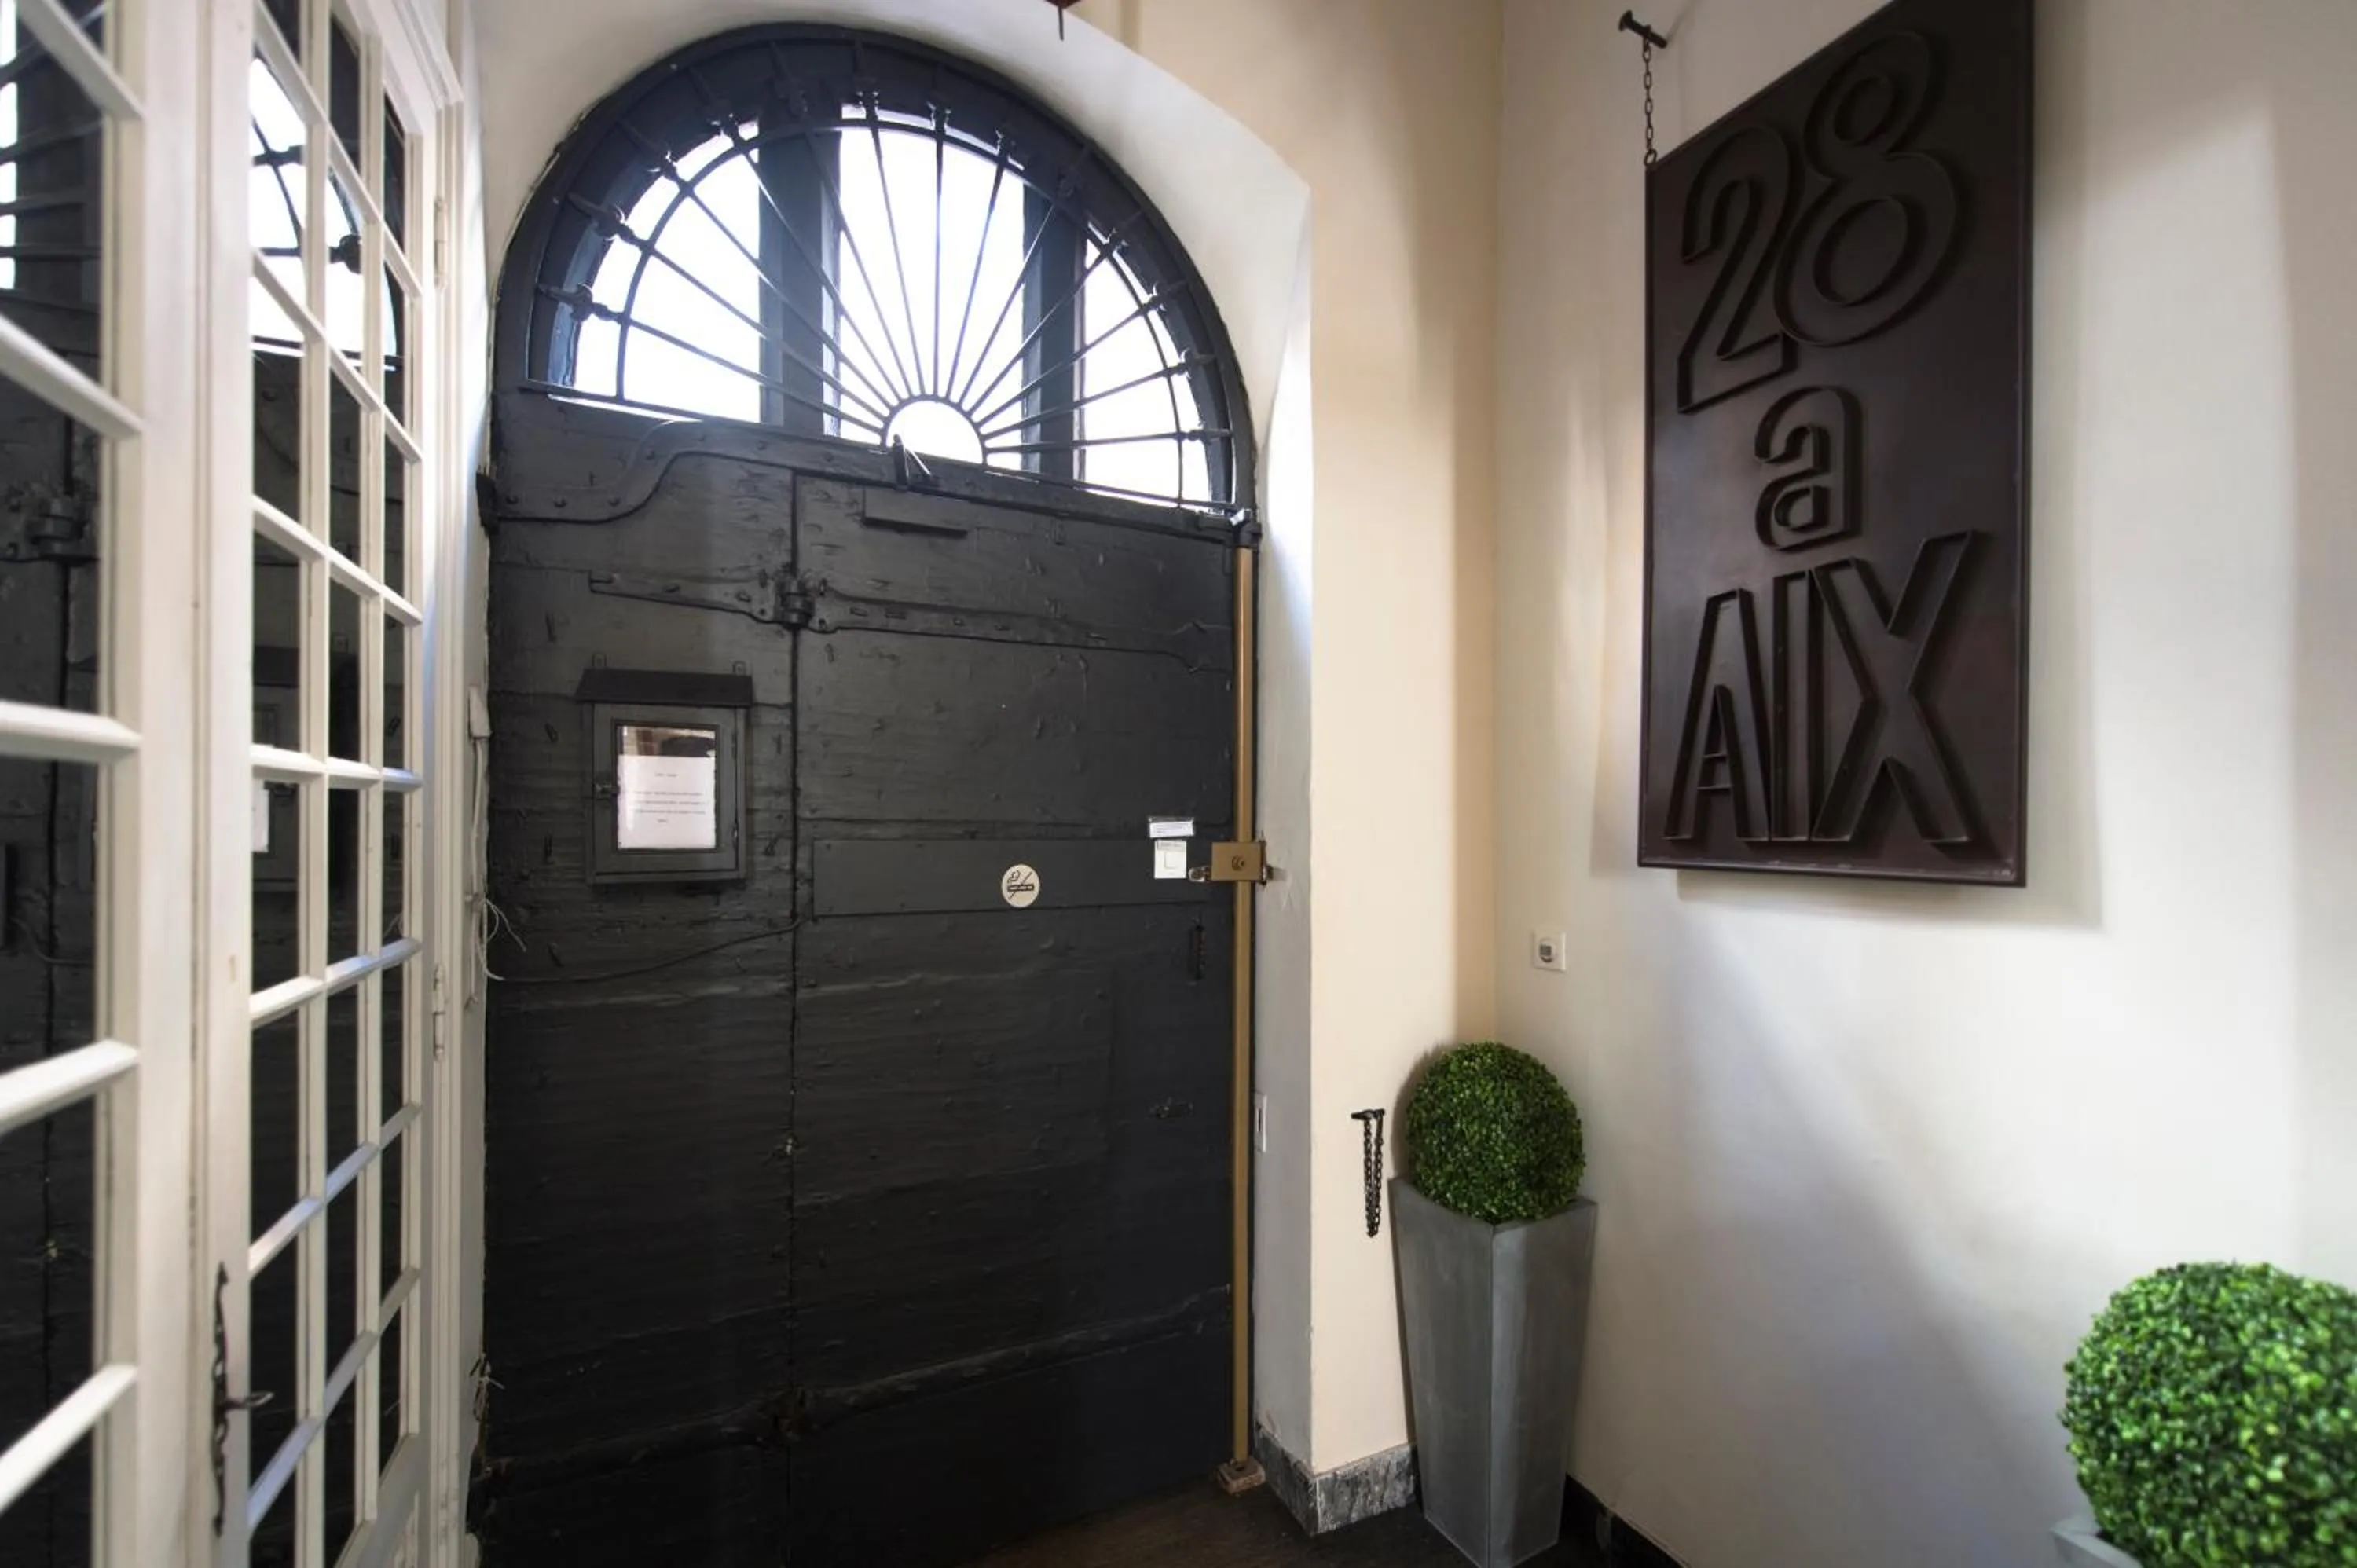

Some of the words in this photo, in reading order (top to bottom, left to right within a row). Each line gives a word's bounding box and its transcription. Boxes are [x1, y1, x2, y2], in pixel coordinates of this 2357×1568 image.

[1677, 29, 1957, 413] 28
[1755, 385, 1861, 551] a
[1664, 529, 1976, 842] AIX
